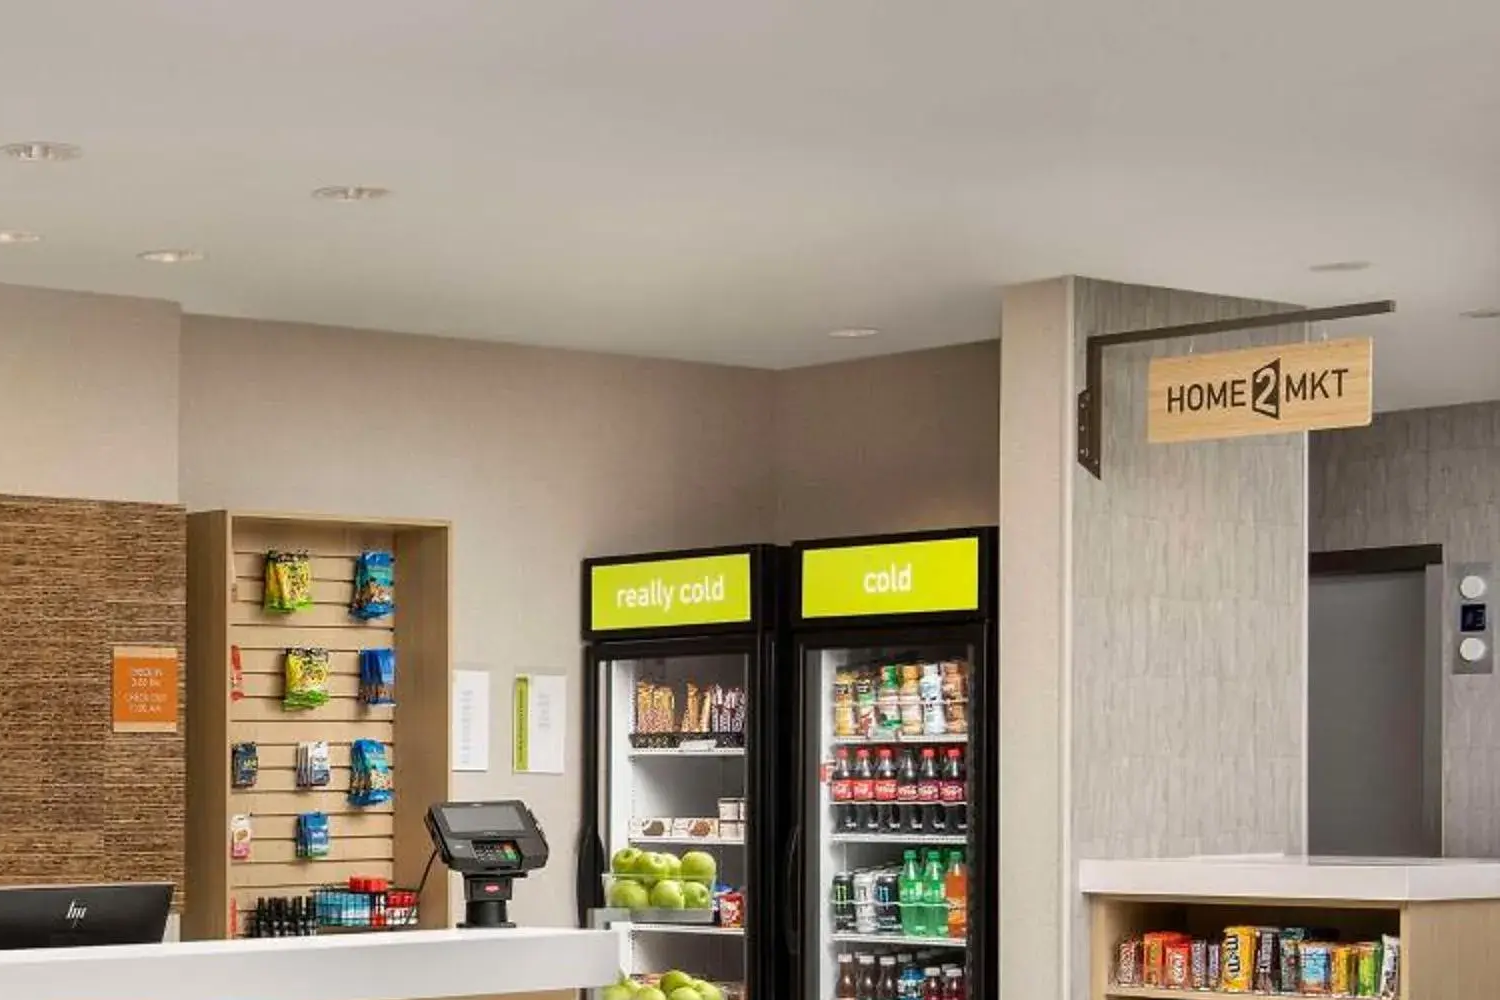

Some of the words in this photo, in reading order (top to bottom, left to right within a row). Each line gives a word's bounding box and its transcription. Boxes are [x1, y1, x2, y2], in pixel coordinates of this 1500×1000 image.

[1285, 368, 1349, 403] MKT
[616, 577, 675, 612] really
[679, 575, 725, 604] cold
[863, 562, 912, 594] cold
